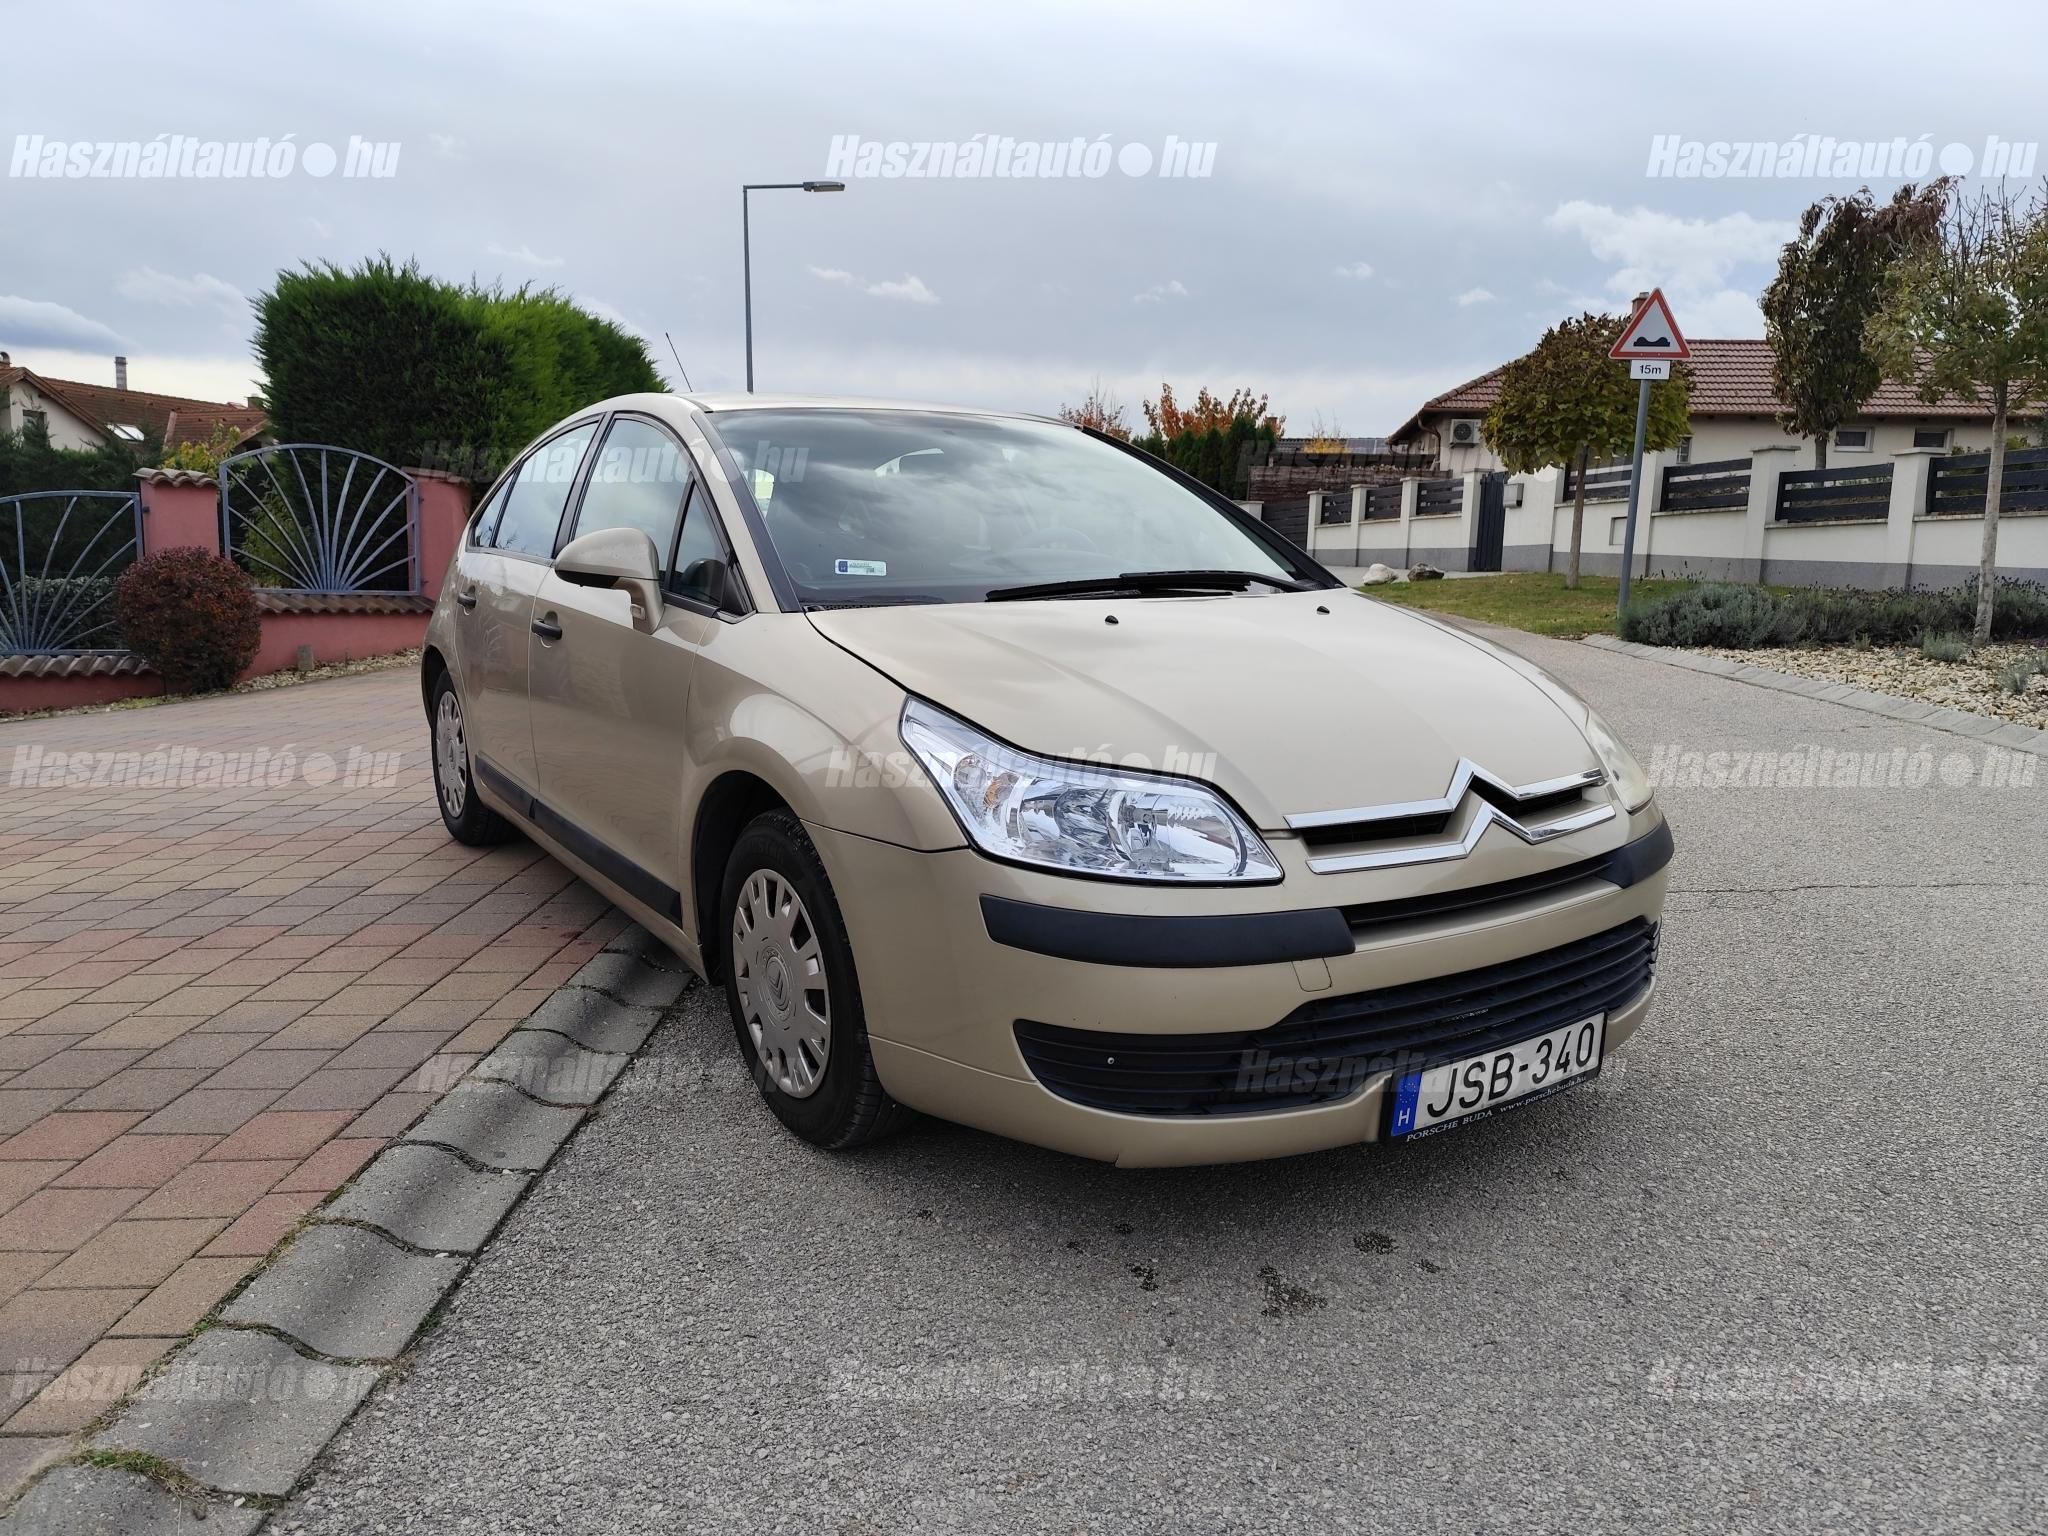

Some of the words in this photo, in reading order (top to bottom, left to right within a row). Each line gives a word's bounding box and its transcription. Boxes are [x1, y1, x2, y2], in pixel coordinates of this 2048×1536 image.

[1639, 365, 1662, 375] 15m
[1427, 1022, 1595, 1117] JSB-340
[1398, 1108, 1410, 1126] H
[1406, 1121, 1458, 1142] PORSCHE
[1462, 1110, 1493, 1125] BUDA
[1500, 1076, 1586, 1112] www.porschebuda.hu
